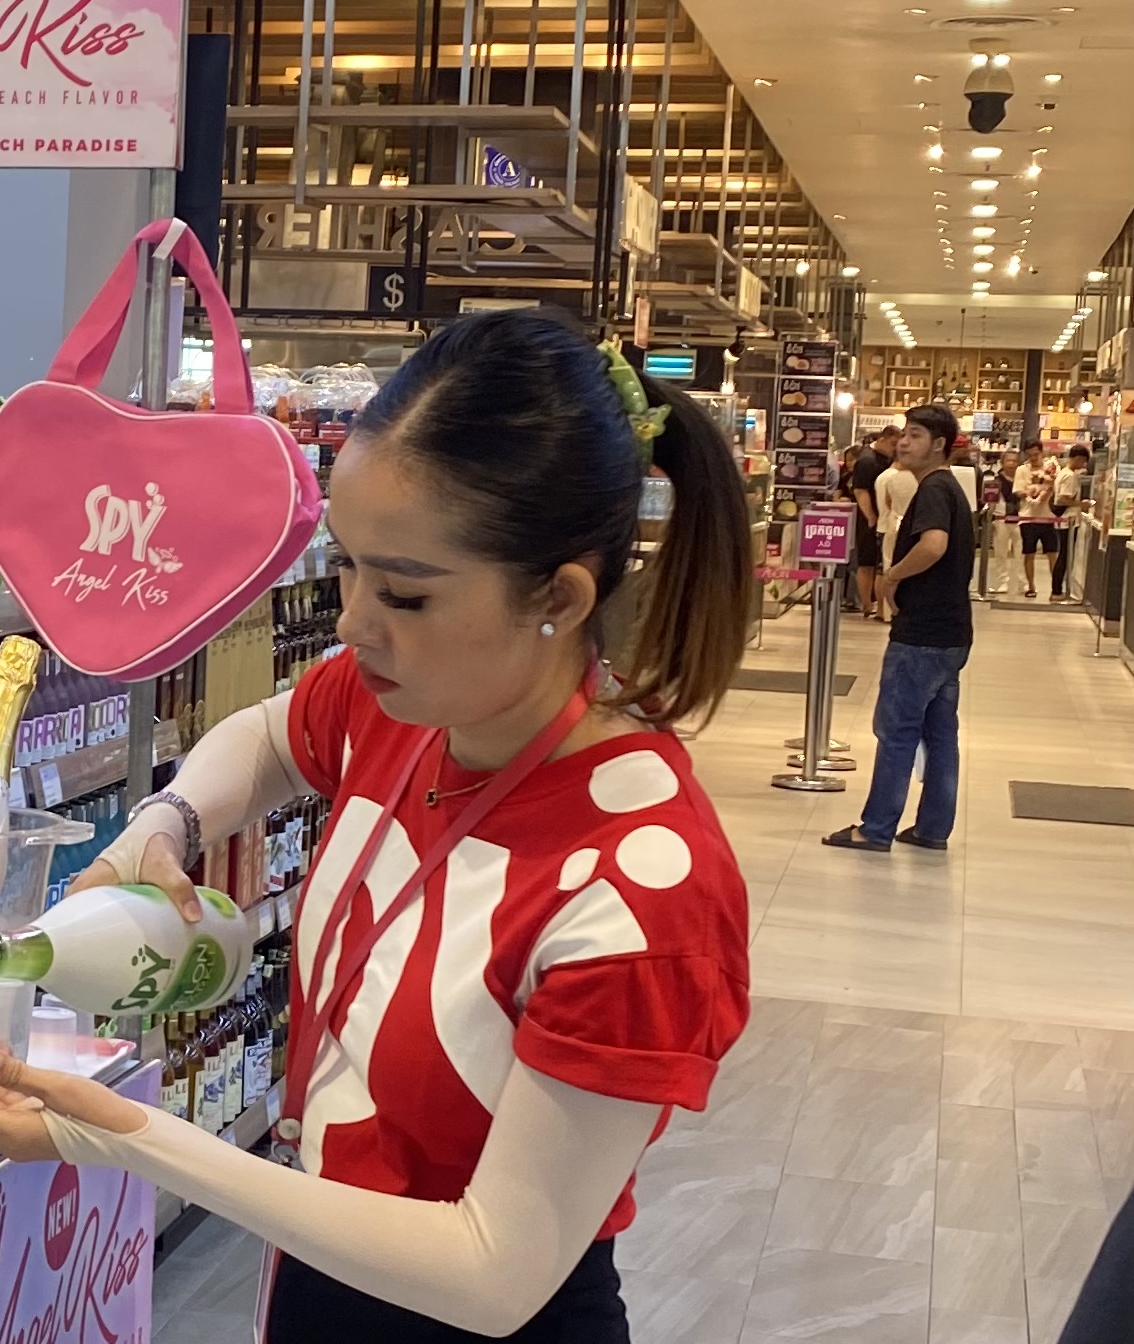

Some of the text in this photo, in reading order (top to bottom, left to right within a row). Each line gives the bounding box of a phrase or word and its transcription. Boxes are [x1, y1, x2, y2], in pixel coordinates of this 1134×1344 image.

[62, 90, 139, 105] FLAVOR
[35, 138, 138, 152] PARADISE
[79, 482, 168, 563] SPY
[51, 558, 170, 611] Angel Kiss
[111, 943, 172, 1012] SPY
[47, 1188, 77, 1242] NEW!
